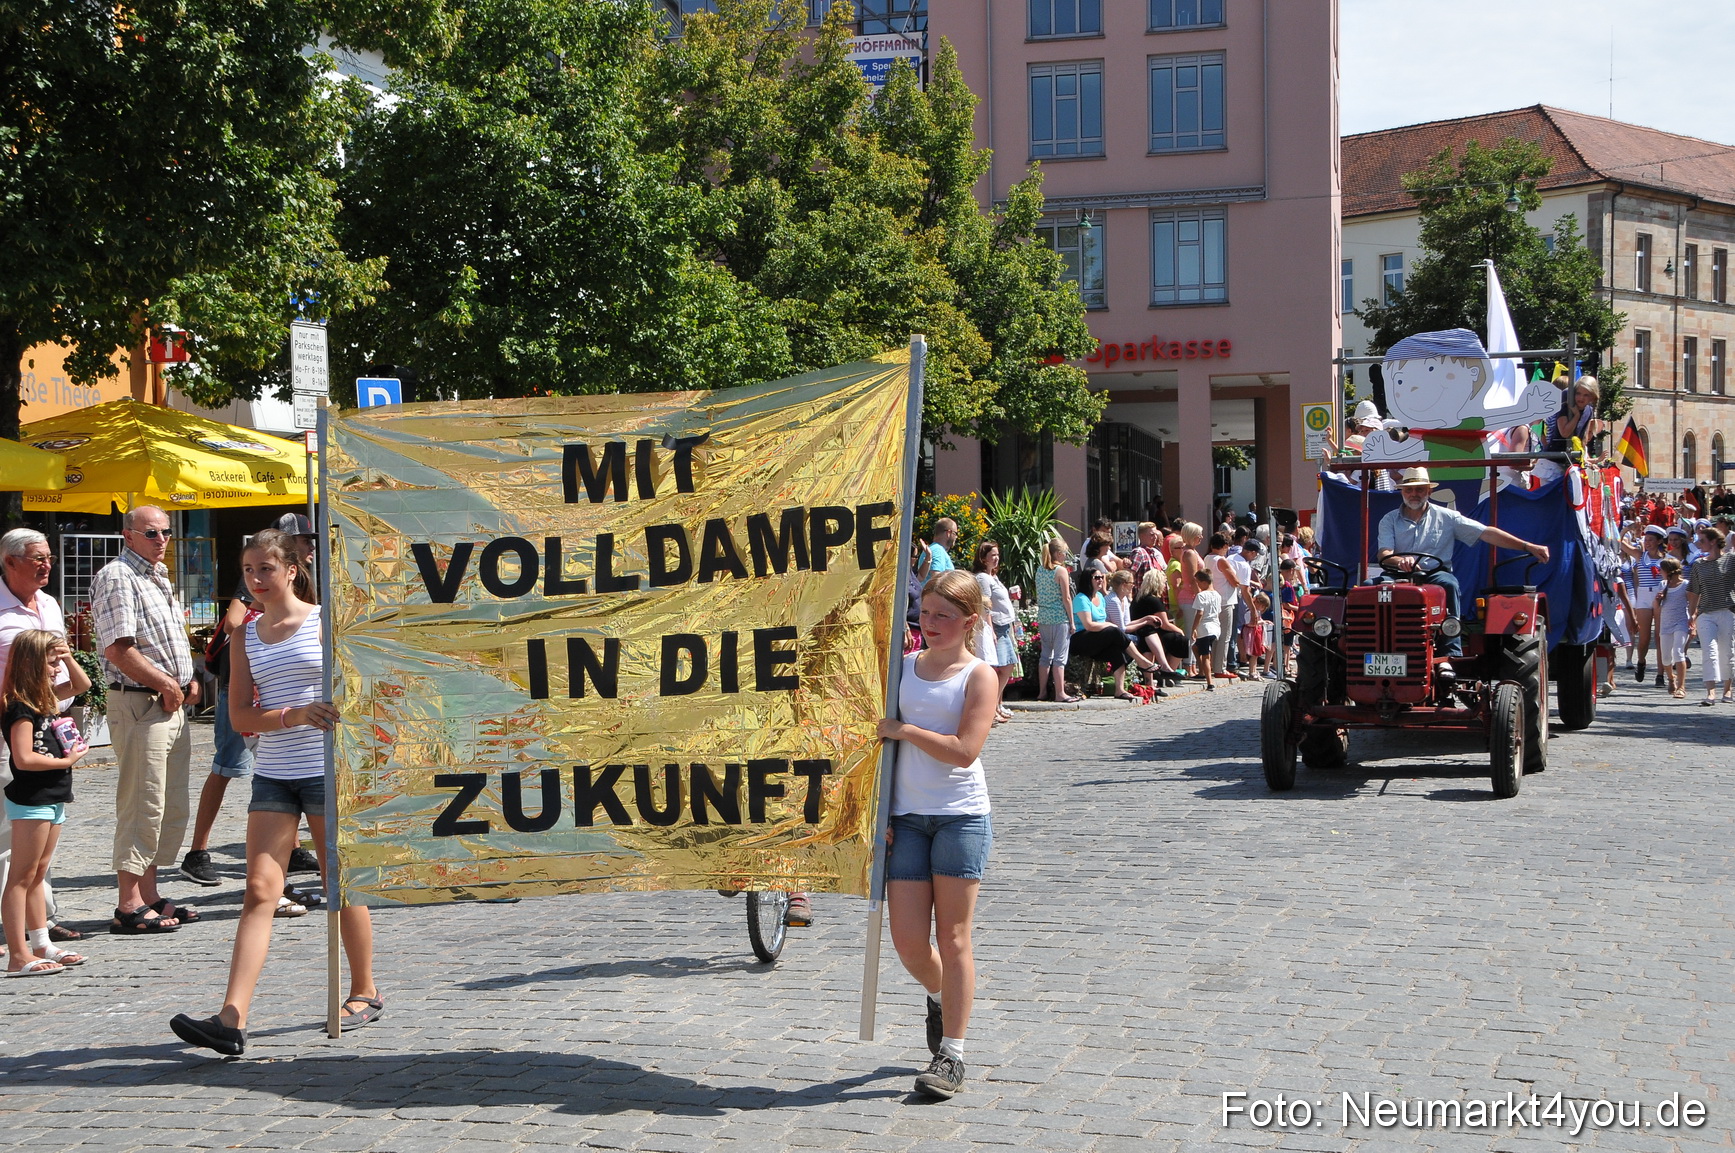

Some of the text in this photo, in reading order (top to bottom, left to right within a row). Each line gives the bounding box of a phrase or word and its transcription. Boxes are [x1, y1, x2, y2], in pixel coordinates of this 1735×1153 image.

[299, 331, 319, 340] nur mit
[294, 340, 325, 352] Parkschein
[1086, 335, 1232, 368] Sparkasse
[297, 352, 323, 364] werktags
[294, 365, 310, 374] Mo-Fr
[295, 376, 302, 385] Sa
[51, 377, 101, 408] Theke
[561, 432, 710, 503] MIT
[209, 470, 247, 483] Bäckerei
[256, 471, 275, 483] Café
[410, 502, 894, 604] VOLLDAMPF
[526, 625, 800, 699] IN DIE
[1374, 655, 1388, 665] NM
[1367, 665, 1403, 675] SM 691
[432, 758, 832, 837] ZUKUNFT
